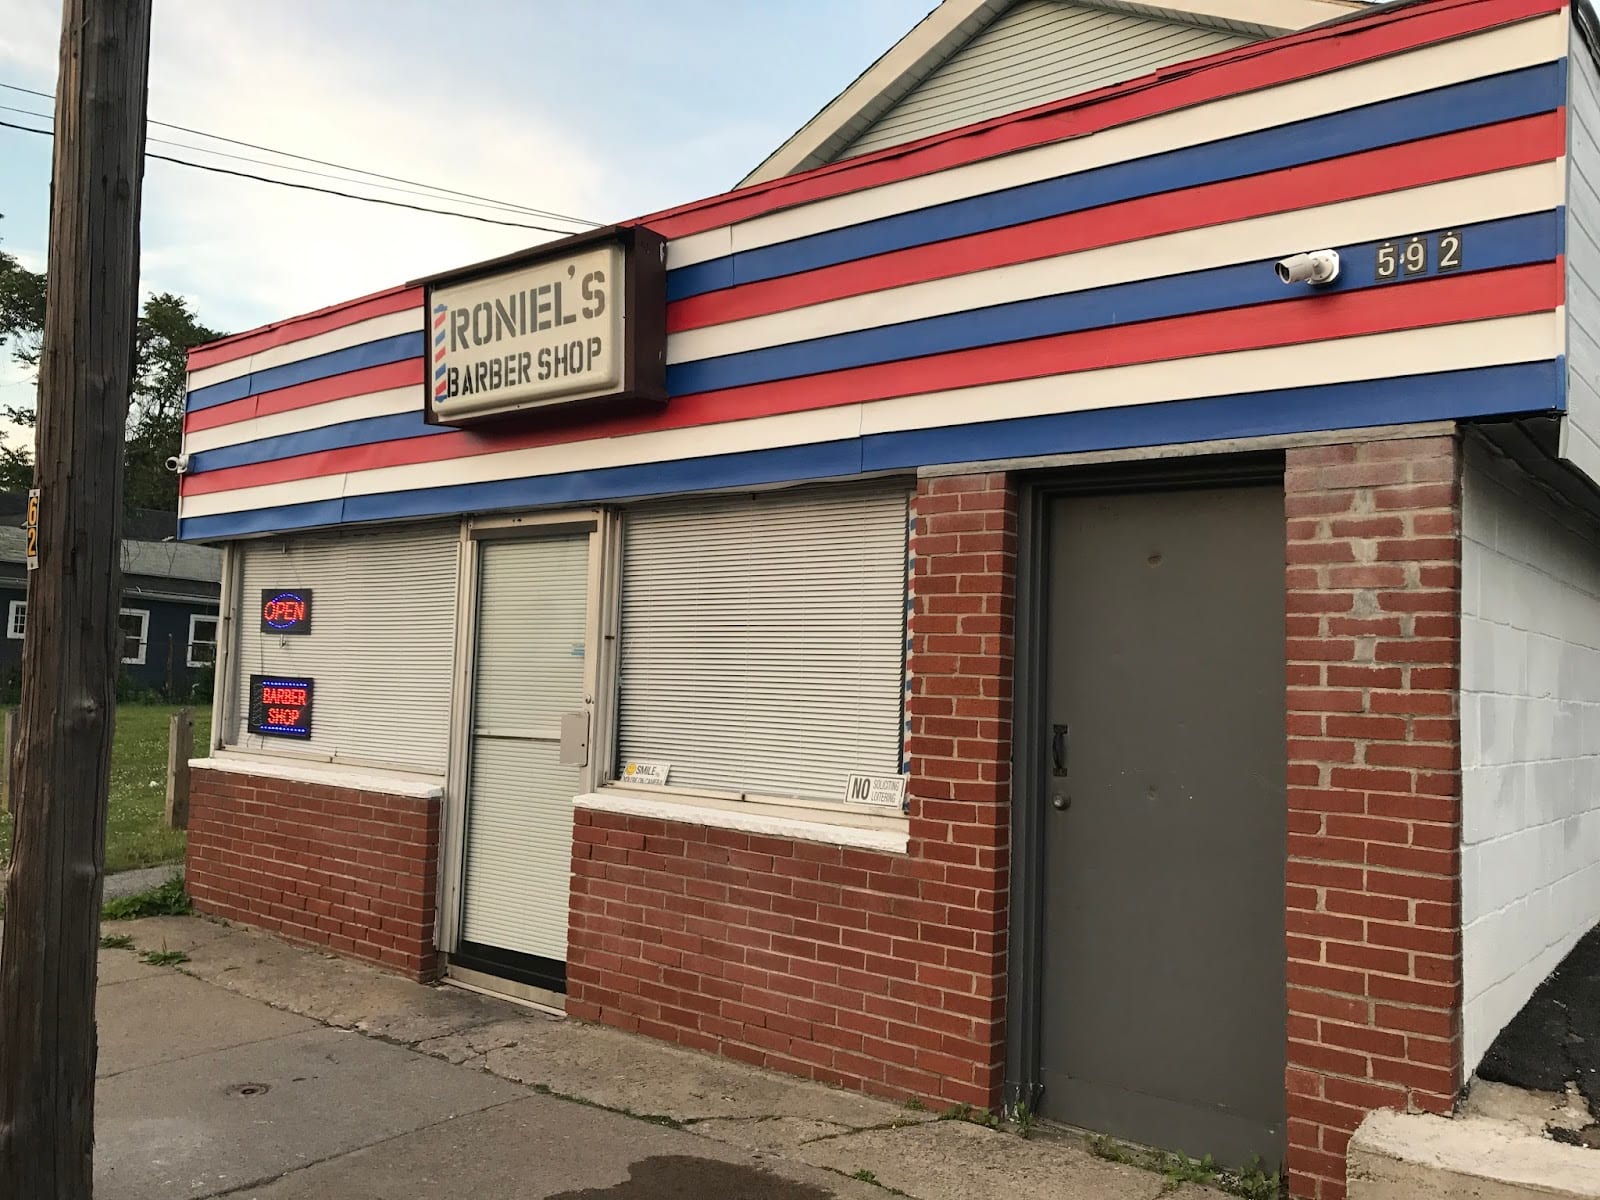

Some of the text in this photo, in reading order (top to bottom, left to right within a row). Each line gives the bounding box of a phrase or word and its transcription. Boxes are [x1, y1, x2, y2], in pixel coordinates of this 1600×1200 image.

[1377, 236, 1459, 276] 592
[450, 264, 606, 353] RONIEL'S
[447, 336, 602, 398] BARBER SHOP
[263, 601, 305, 621] OPEN
[262, 687, 307, 706] BARBER
[267, 708, 300, 726] SHOP
[636, 765, 657, 776] SMILE
[851, 777, 871, 800] NO
[873, 779, 899, 791] SOLICITING
[871, 791, 897, 803] LOITERING
